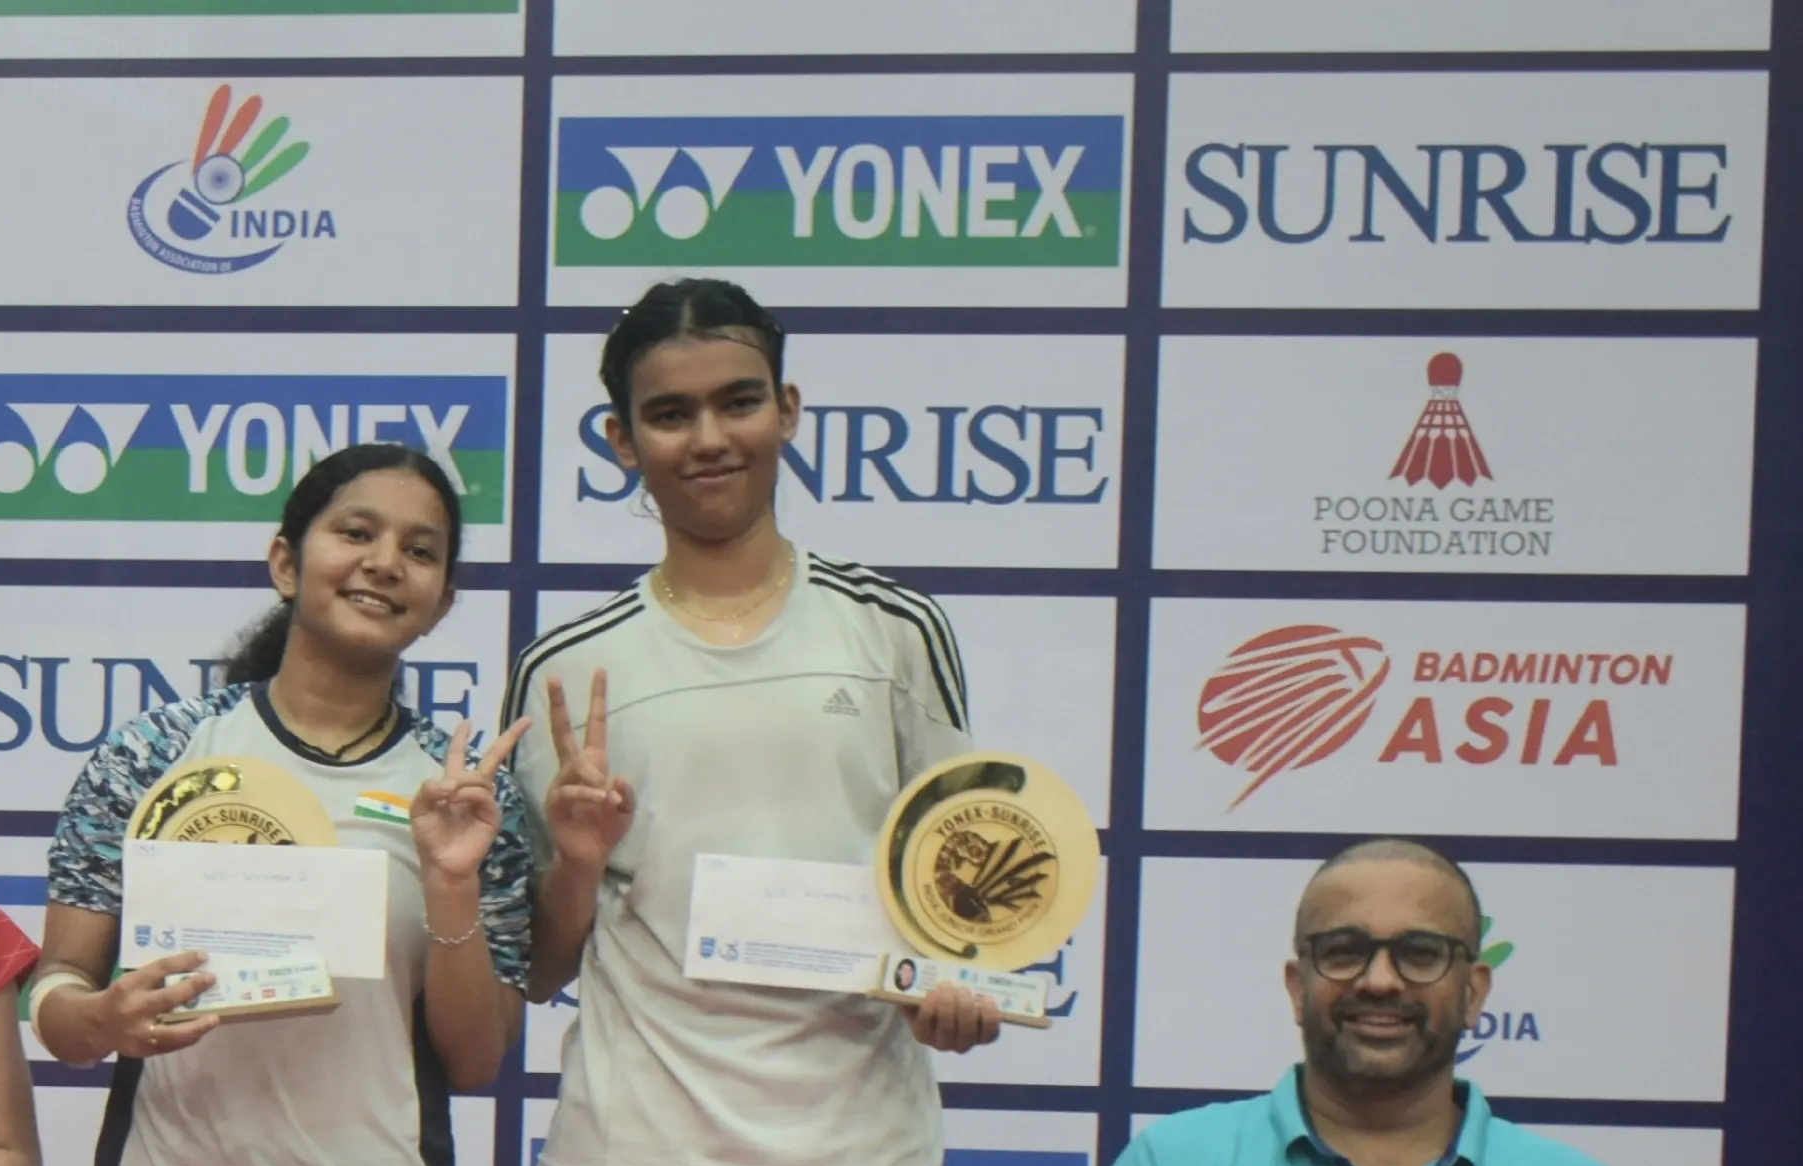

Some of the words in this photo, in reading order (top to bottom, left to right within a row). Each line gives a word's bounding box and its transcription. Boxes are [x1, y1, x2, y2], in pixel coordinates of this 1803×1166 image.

[775, 144, 1085, 240] YONEX
[1183, 142, 1732, 245] SUNRISE
[231, 210, 336, 239] INDIA
[577, 402, 1109, 506] SNRISE
[1313, 496, 1440, 522] POONA
[1449, 497, 1554, 523] GAME
[1321, 529, 1553, 556] FOUNDATION
[1413, 651, 1673, 686] BADMINTON
[1378, 696, 1618, 767] ASIA
[177, 807, 283, 843] ONEX-SUNRISE
[1460, 1012, 1540, 1041] DIA
